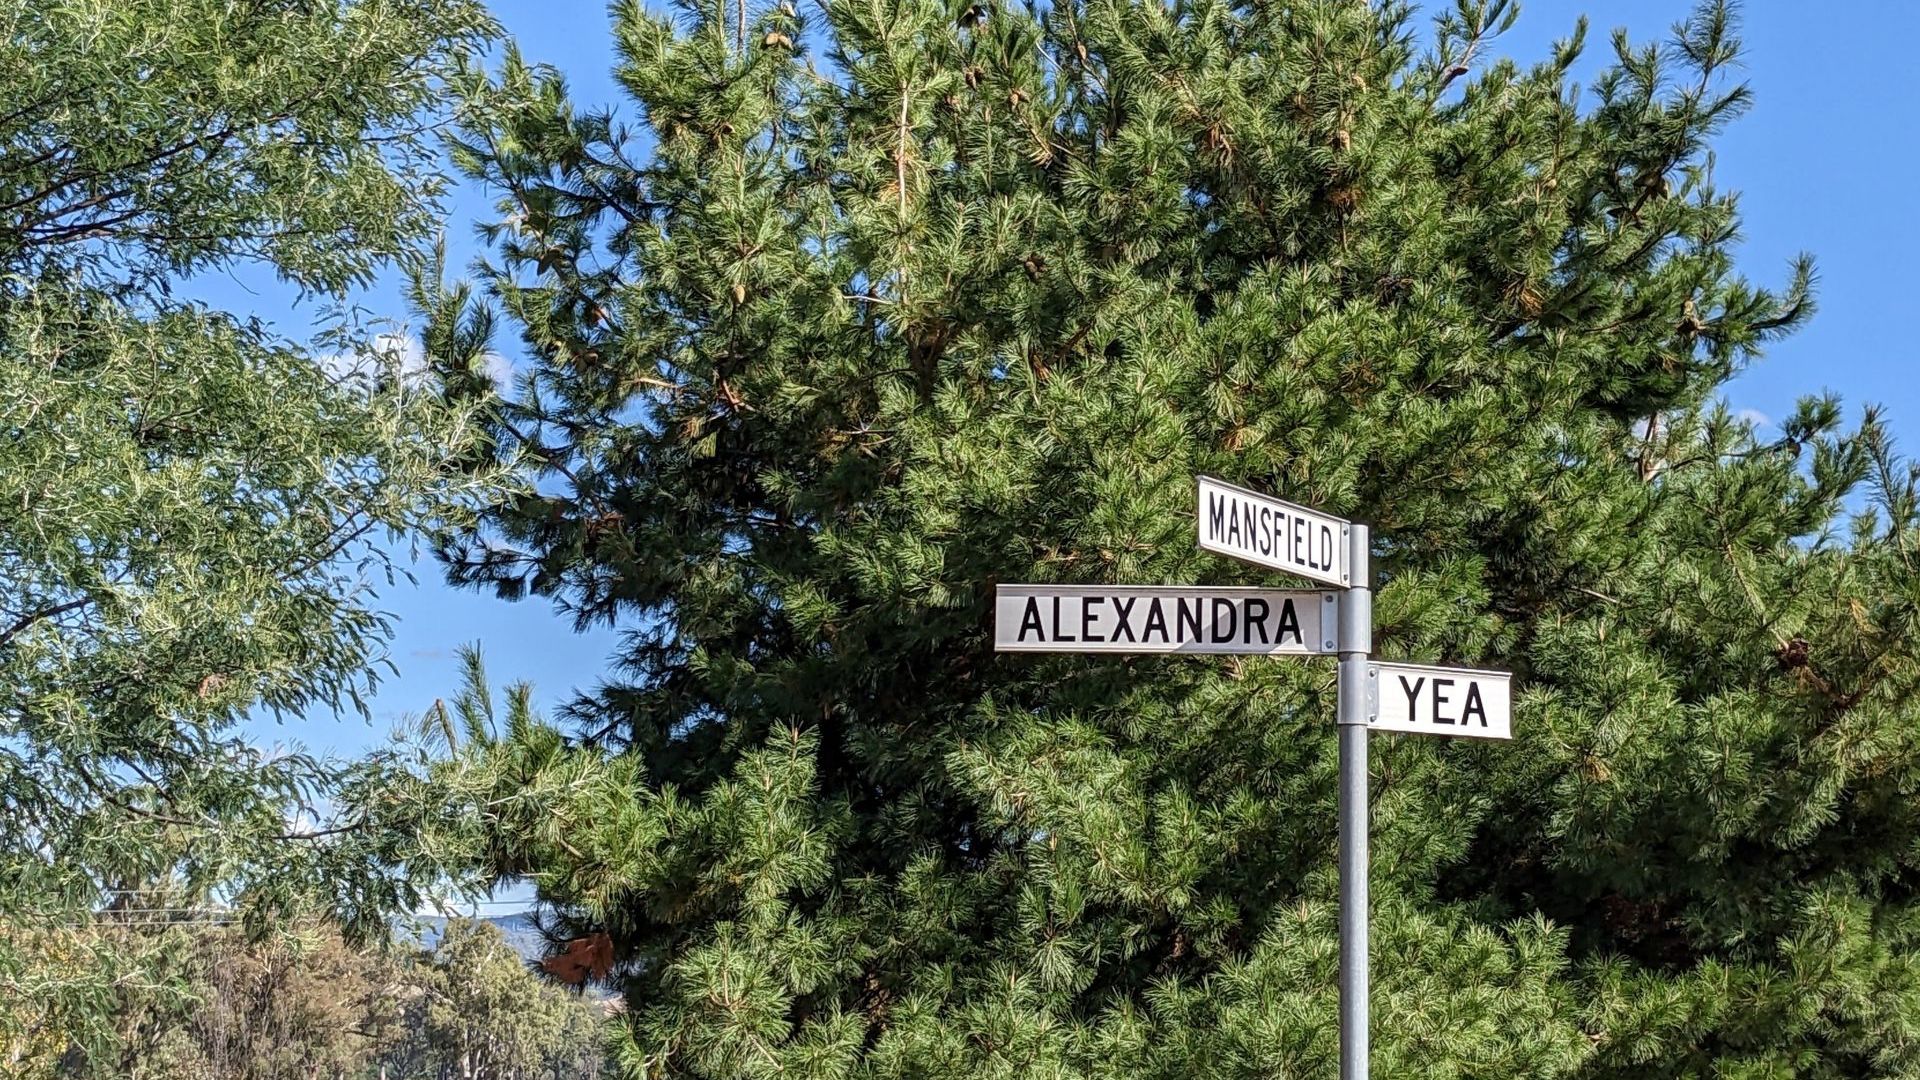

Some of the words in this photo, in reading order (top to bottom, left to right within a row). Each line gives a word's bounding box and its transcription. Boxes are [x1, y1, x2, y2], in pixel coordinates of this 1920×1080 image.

[1209, 491, 1333, 572] MANSFIELD
[1017, 596, 1303, 644] ALEXANDRA
[1398, 675, 1488, 728] YEA
